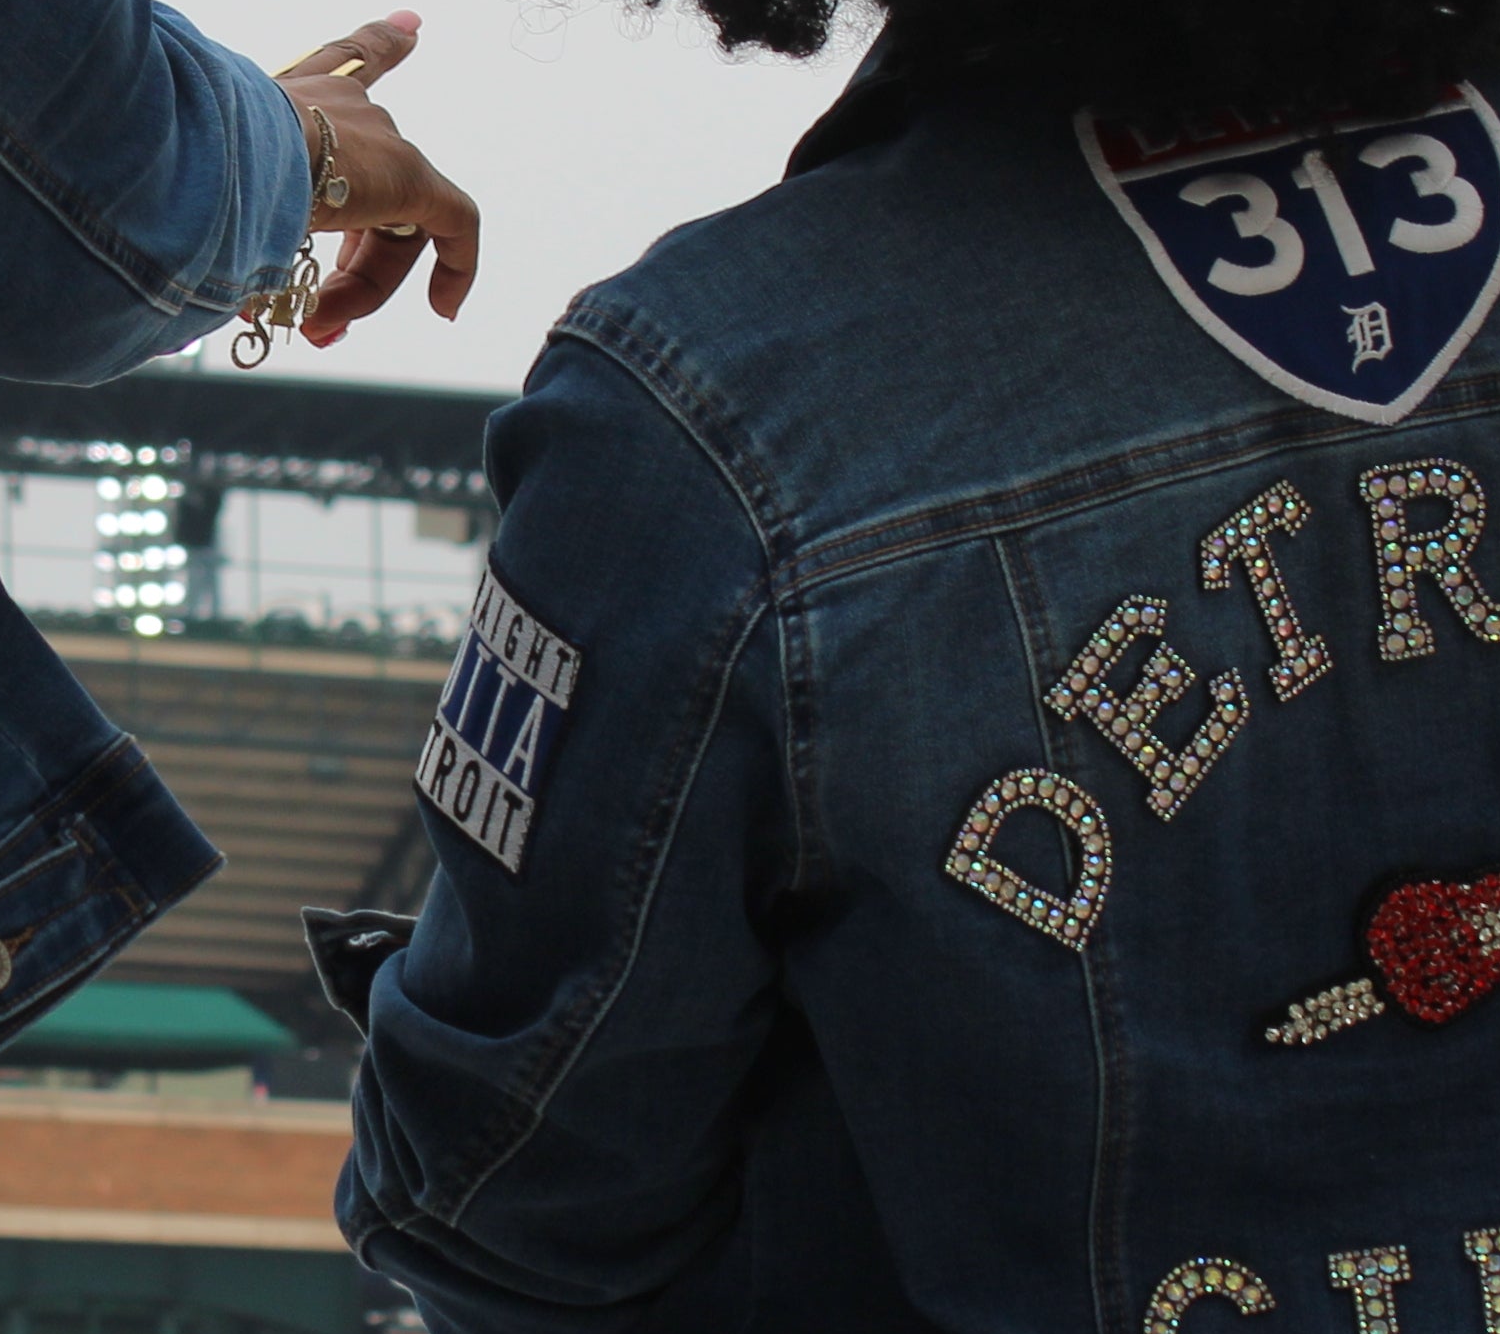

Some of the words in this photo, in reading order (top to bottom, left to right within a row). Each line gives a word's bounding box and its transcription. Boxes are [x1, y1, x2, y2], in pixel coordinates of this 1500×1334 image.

[1178, 132, 1485, 297] 313
[1340, 301, 1394, 375] D
[473, 568, 571, 696] AIGHT
